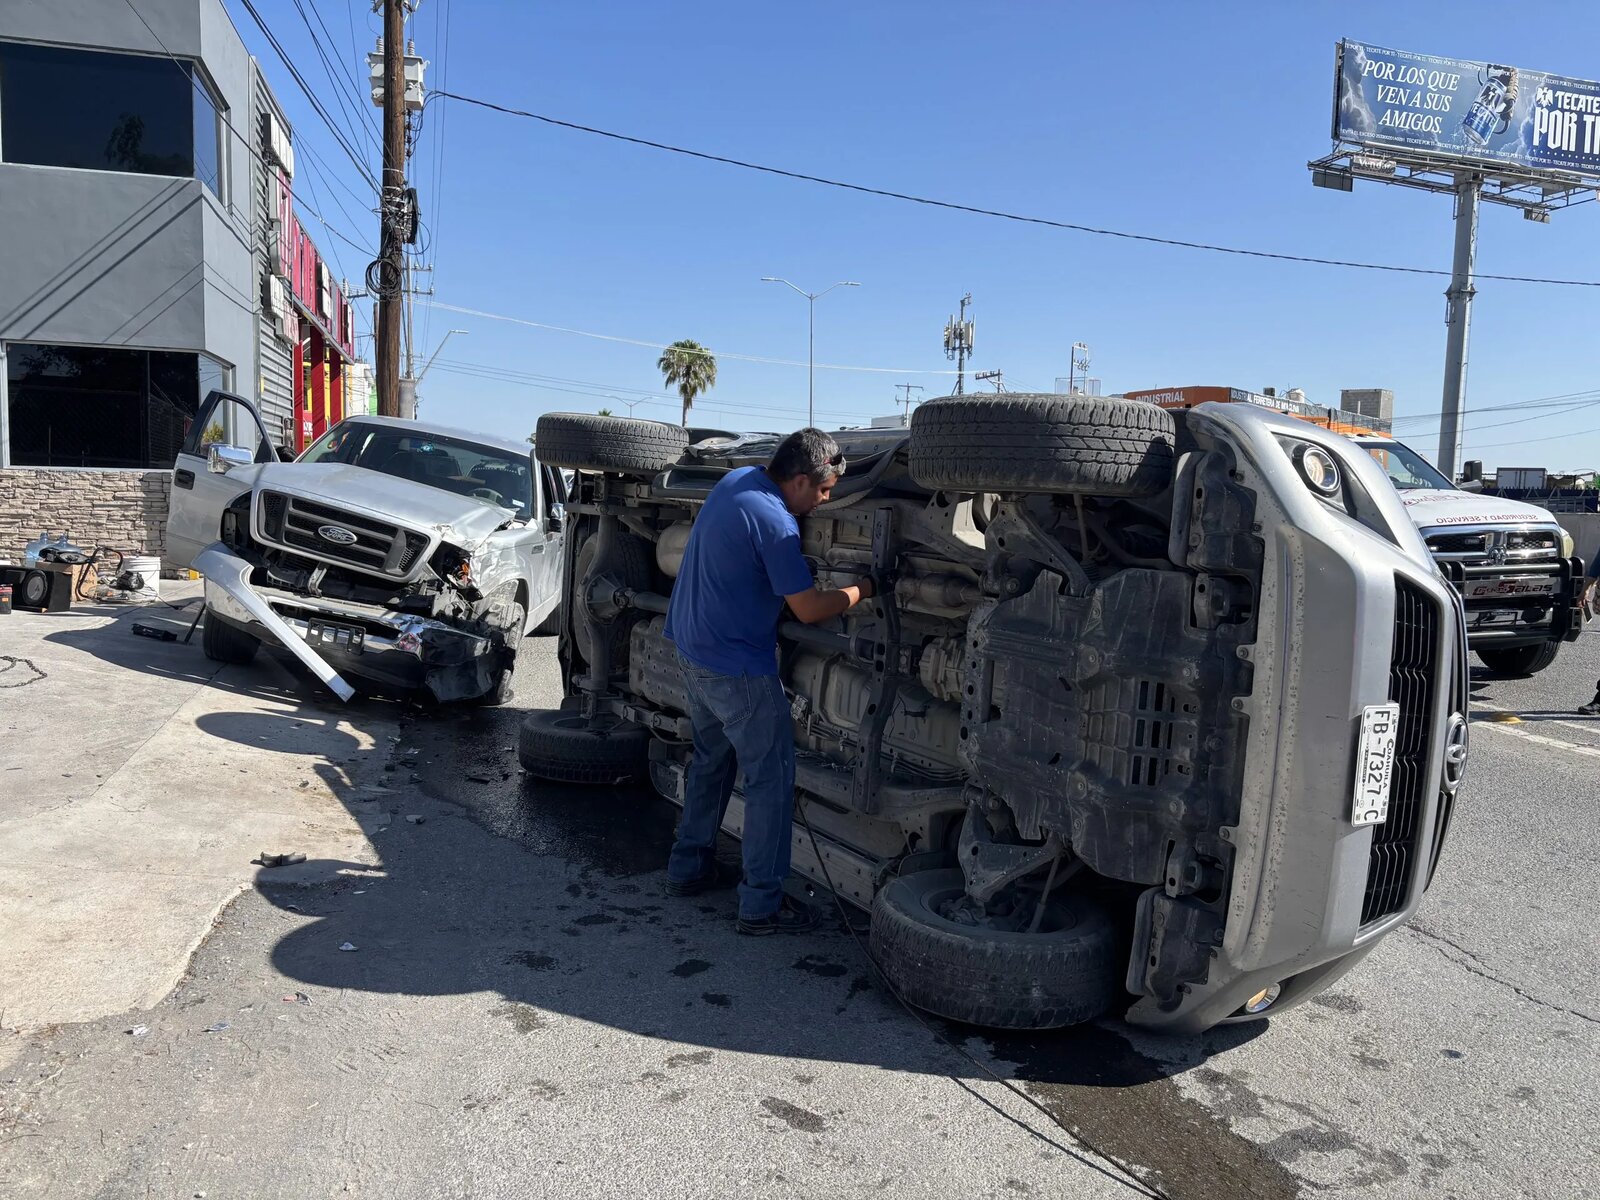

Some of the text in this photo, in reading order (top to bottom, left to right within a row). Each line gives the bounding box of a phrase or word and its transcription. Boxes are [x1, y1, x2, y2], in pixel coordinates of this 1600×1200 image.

[1362, 60, 1460, 92] POR LOS QUE
[1376, 84, 1452, 112] VEN A SUS
[1554, 90, 1600, 114] TECATE
[1378, 108, 1443, 134] AMIGOS.
[1532, 106, 1578, 151] POR
[1363, 710, 1391, 821] FB-7327-C
